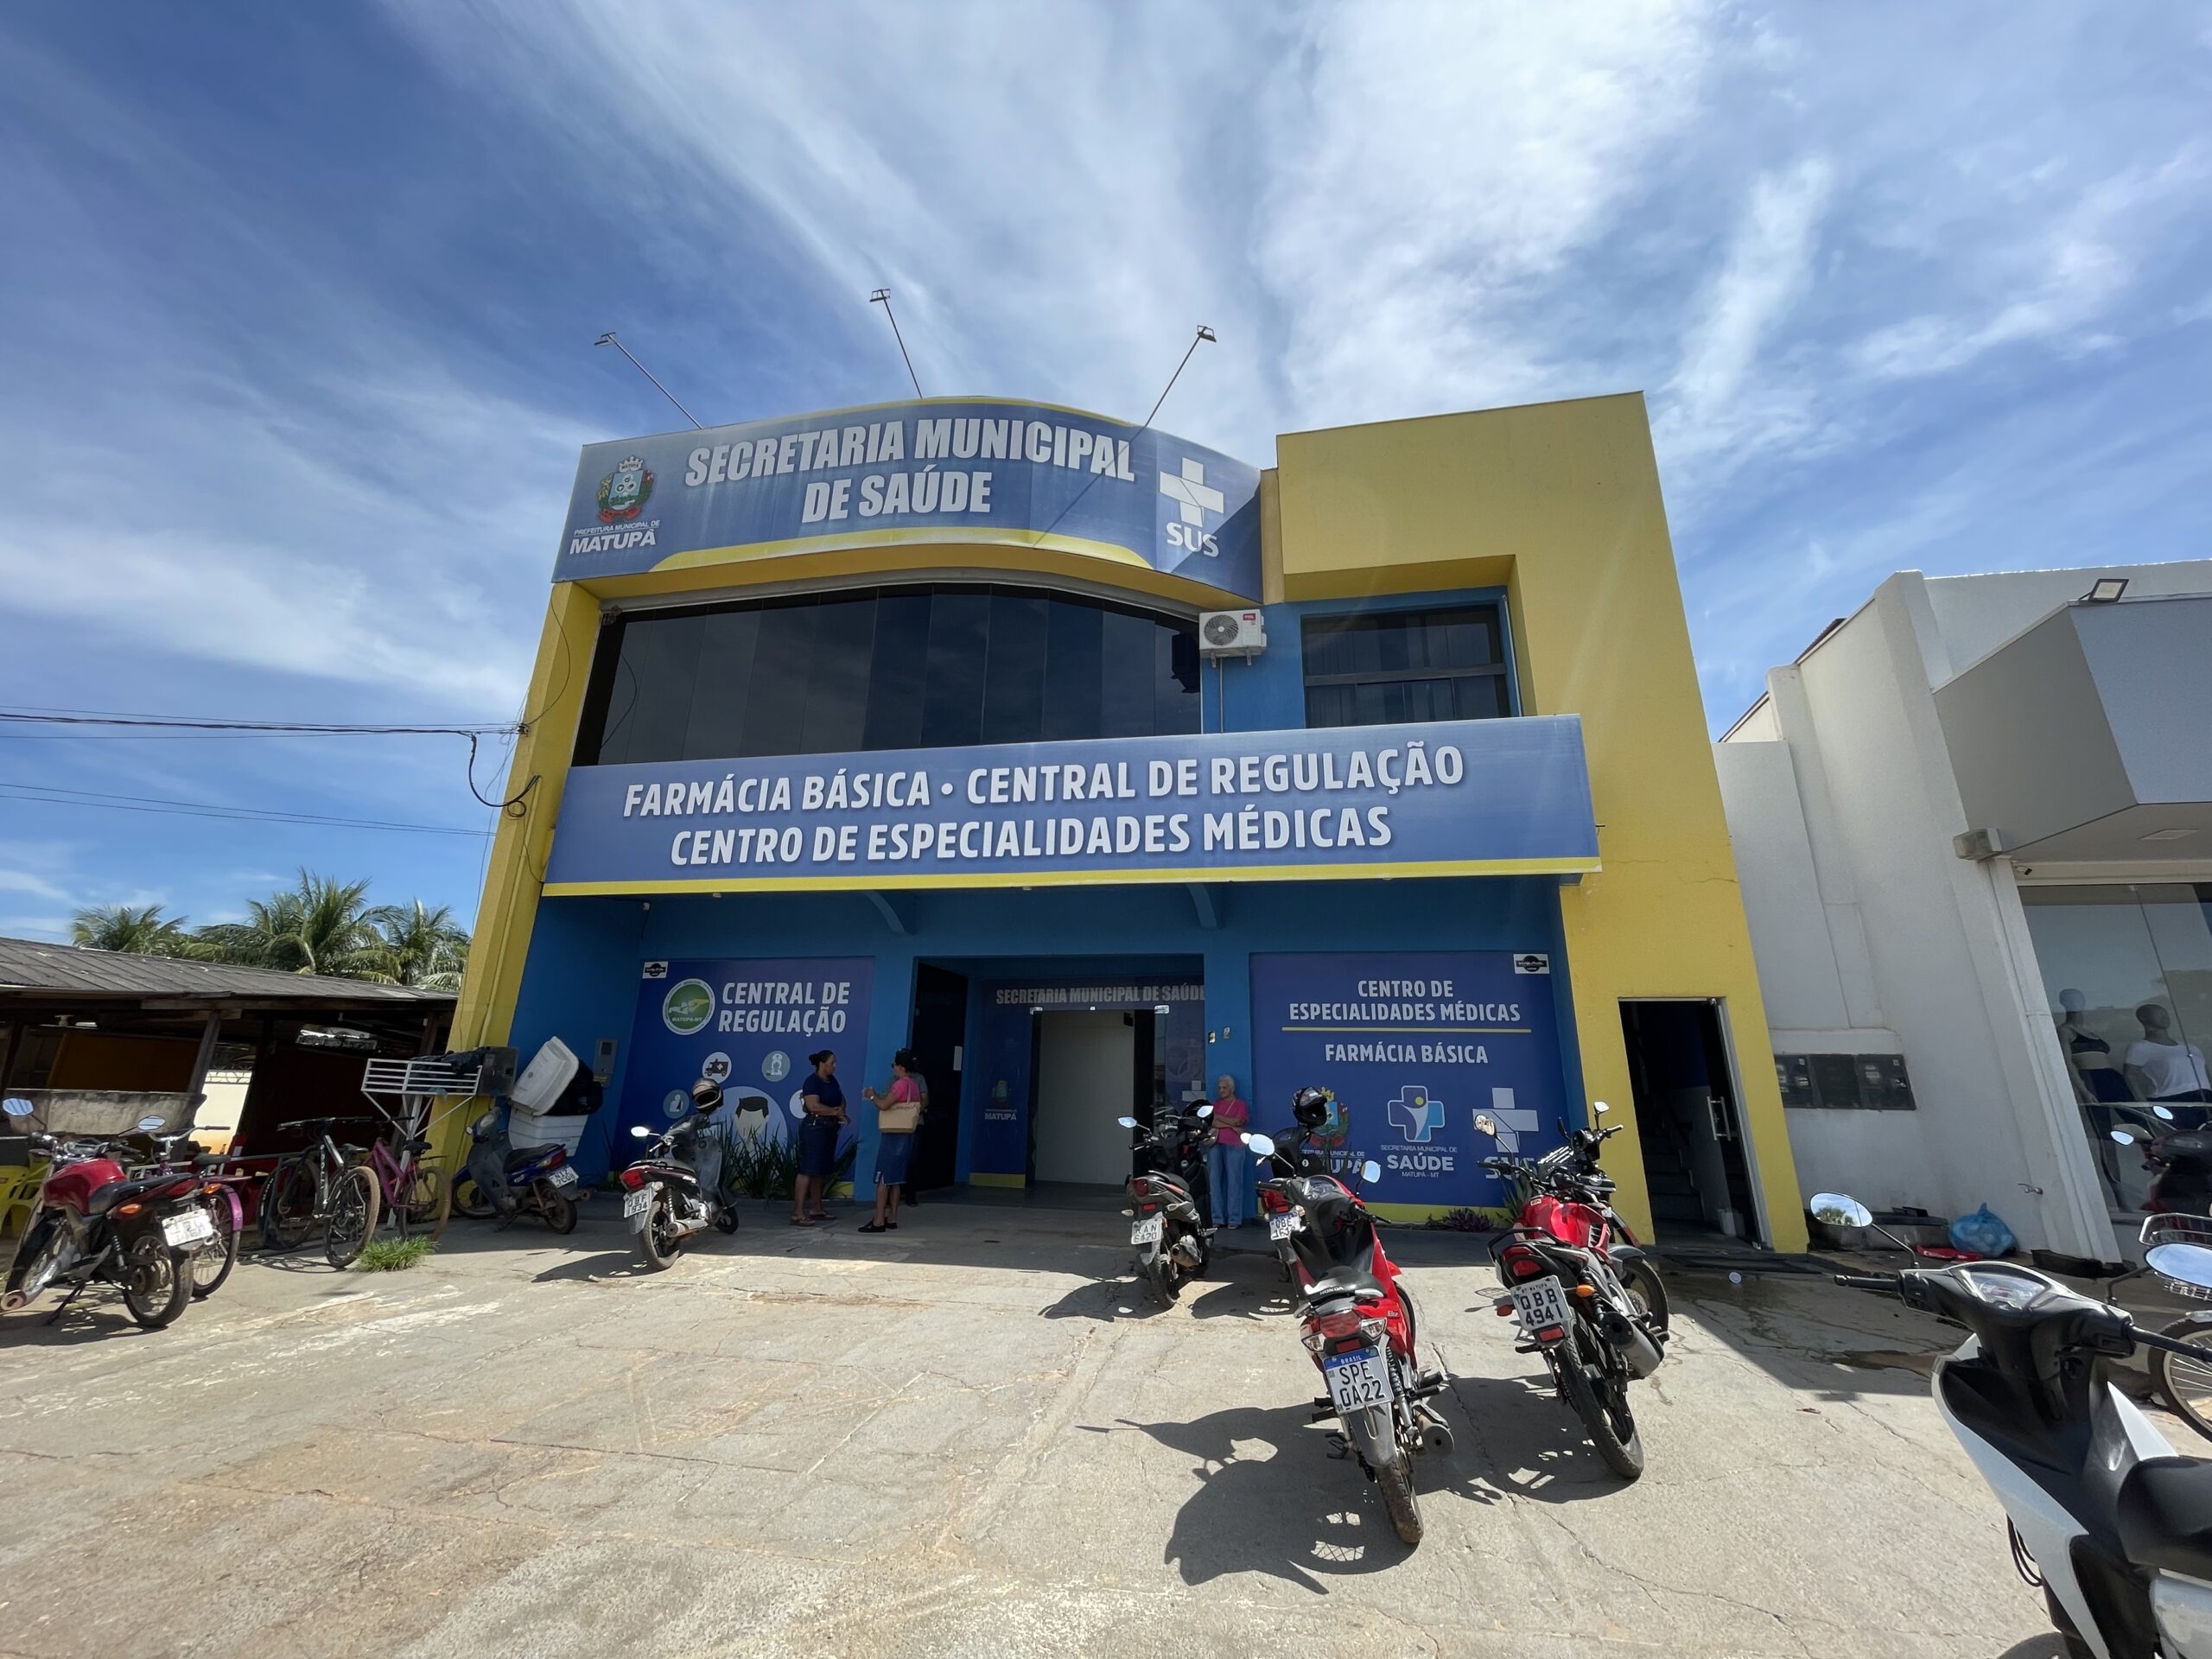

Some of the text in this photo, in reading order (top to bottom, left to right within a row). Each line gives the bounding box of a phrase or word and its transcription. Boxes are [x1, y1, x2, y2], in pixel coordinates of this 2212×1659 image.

[685, 418, 1135, 486] SECRETARIA MUNICIPAL
[802, 465, 993, 524] DE SAÚDE
[574, 525, 613, 535] PREFEITURA
[615, 521, 649, 532] MUNICIPAL
[1166, 522, 1219, 557] SUS
[623, 741, 1464, 817] FARMÁCIA BÁSICA CENTRAL DE REGULAÇÃO
[671, 804, 1391, 865] CENTRO DE ESPECIALIDADES MÉDICAS
[722, 982, 815, 1004] CENTRAL
[822, 982, 850, 1004] DE
[996, 988, 1066, 1004] SECRETARIA
[1070, 987, 1140, 1003] MUNICIPAL
[1142, 986, 1160, 1001] DE
[1358, 981, 1453, 997] CENTRO DE
[718, 1006, 846, 1037] REGULAÇÃO
[1290, 1001, 1521, 1021] ESPECIALIDADES MÉDICAS
[1325, 1041, 1488, 1063] FARMÁCIA BÁSICA
[1387, 1152, 1454, 1171] SAÚDE
[1319, 1286, 1344, 1295] HONDA
[1521, 1288, 1557, 1310] QBB
[1526, 1304, 1562, 1325] 4941
[1340, 1355, 1362, 1364] BRASIL
[1339, 1361, 1373, 1385] SPE
